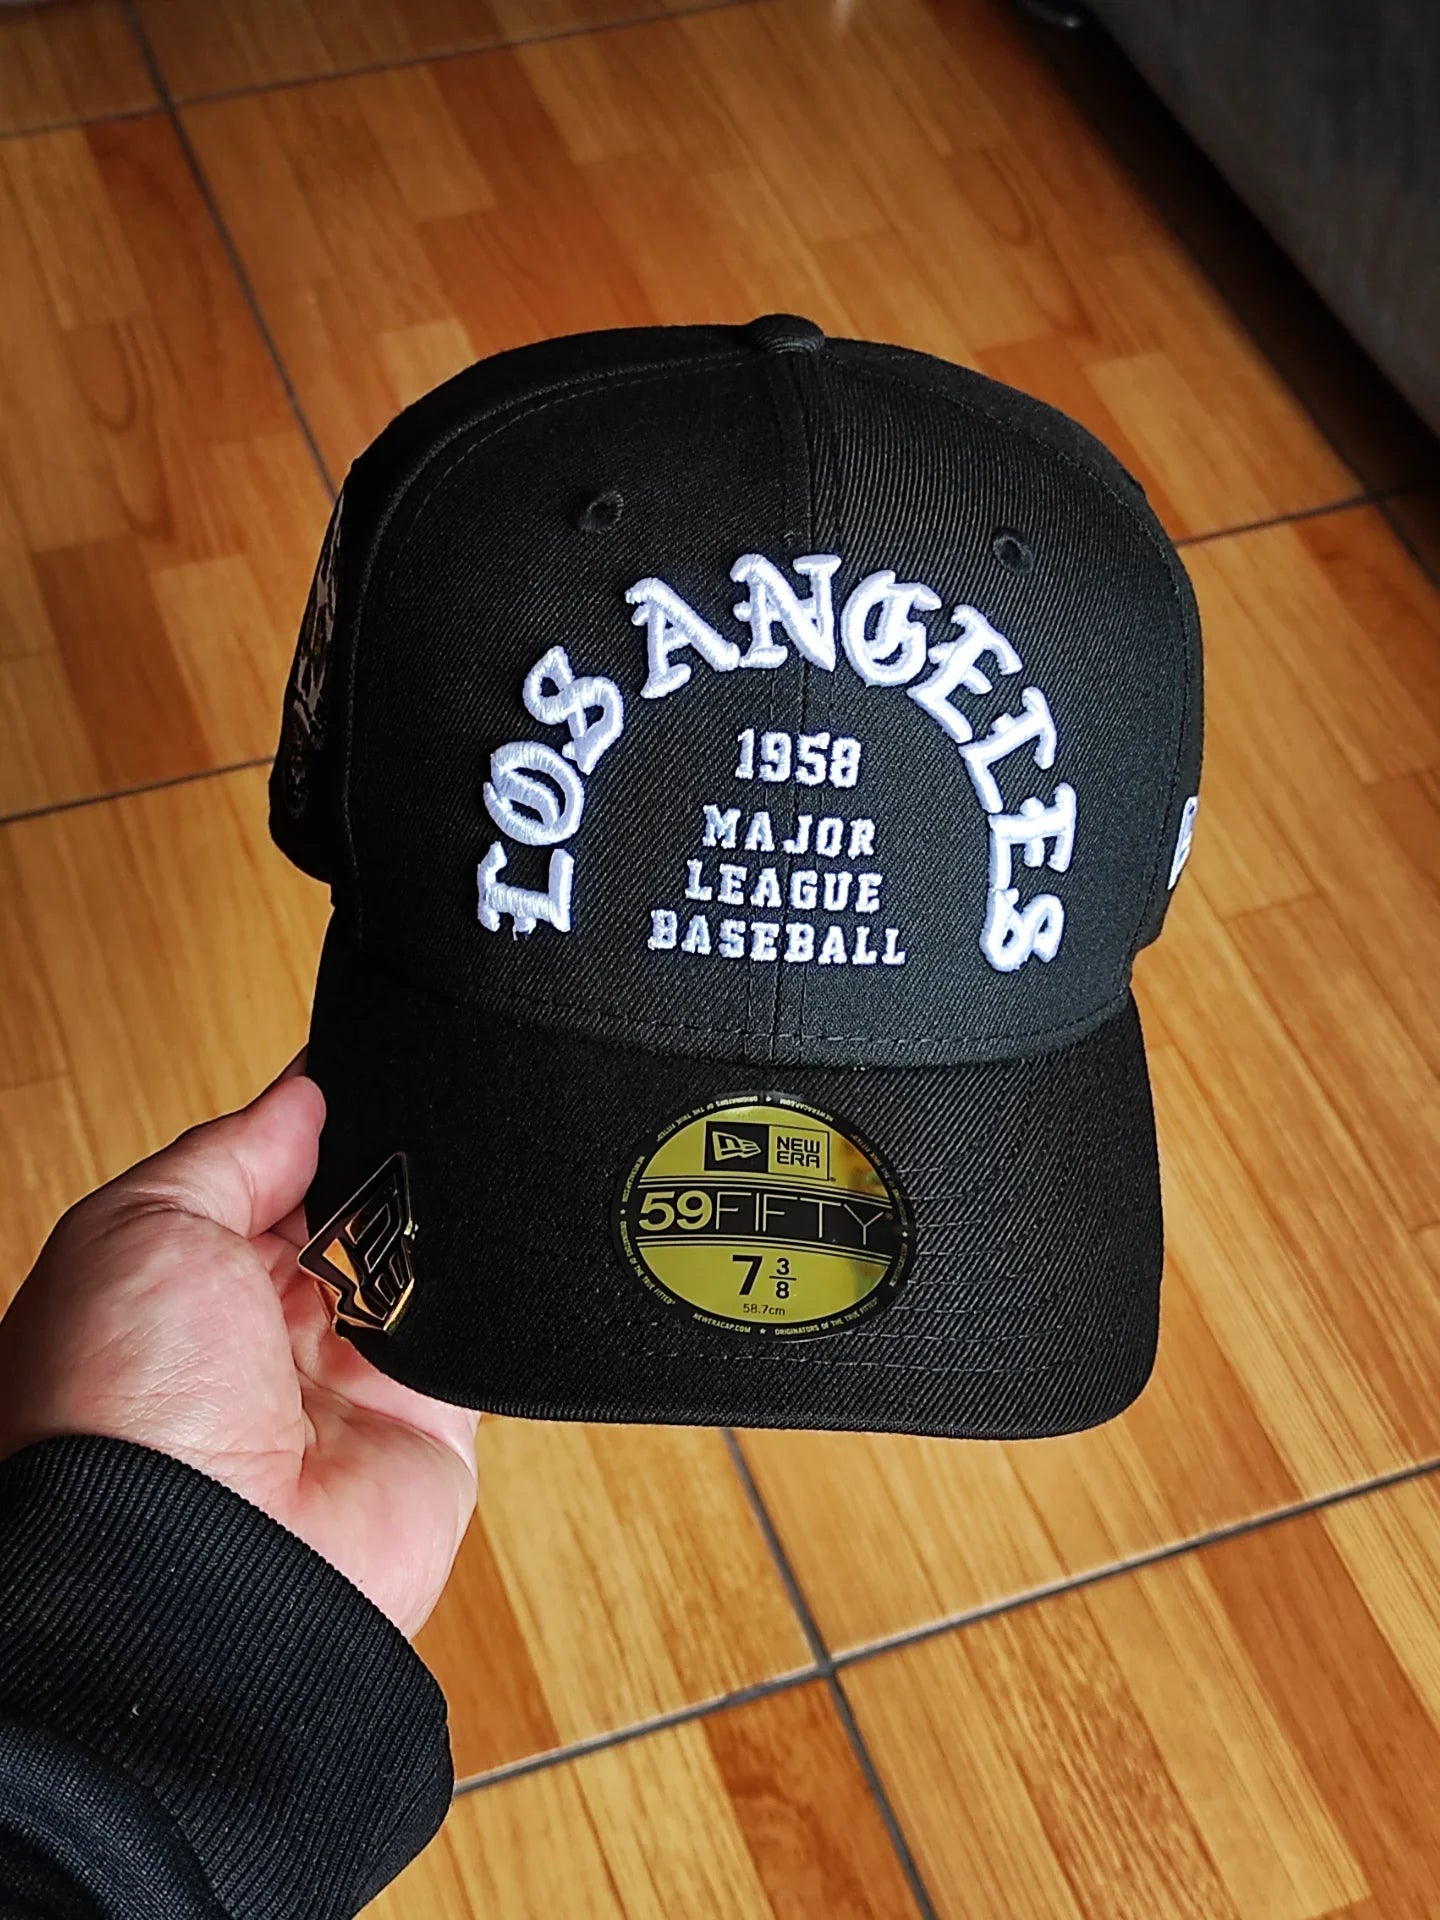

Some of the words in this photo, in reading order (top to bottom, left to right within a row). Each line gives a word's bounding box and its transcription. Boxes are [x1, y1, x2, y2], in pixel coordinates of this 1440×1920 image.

[477, 645, 624, 942] LOS
[625, 553, 1078, 973] ANGELES
[734, 728, 862, 788] 1958
[702, 804, 877, 860] MAJOR
[684, 858, 884, 915] LEAGUE
[647, 908, 908, 967] BASEBALL
[777, 1136, 820, 1154] NEW
[777, 1150, 820, 1169] ERA
[638, 1190, 885, 1246] 59FIFTY
[732, 1254, 763, 1296] 7
[743, 1303, 786, 1316] 58.7cm
